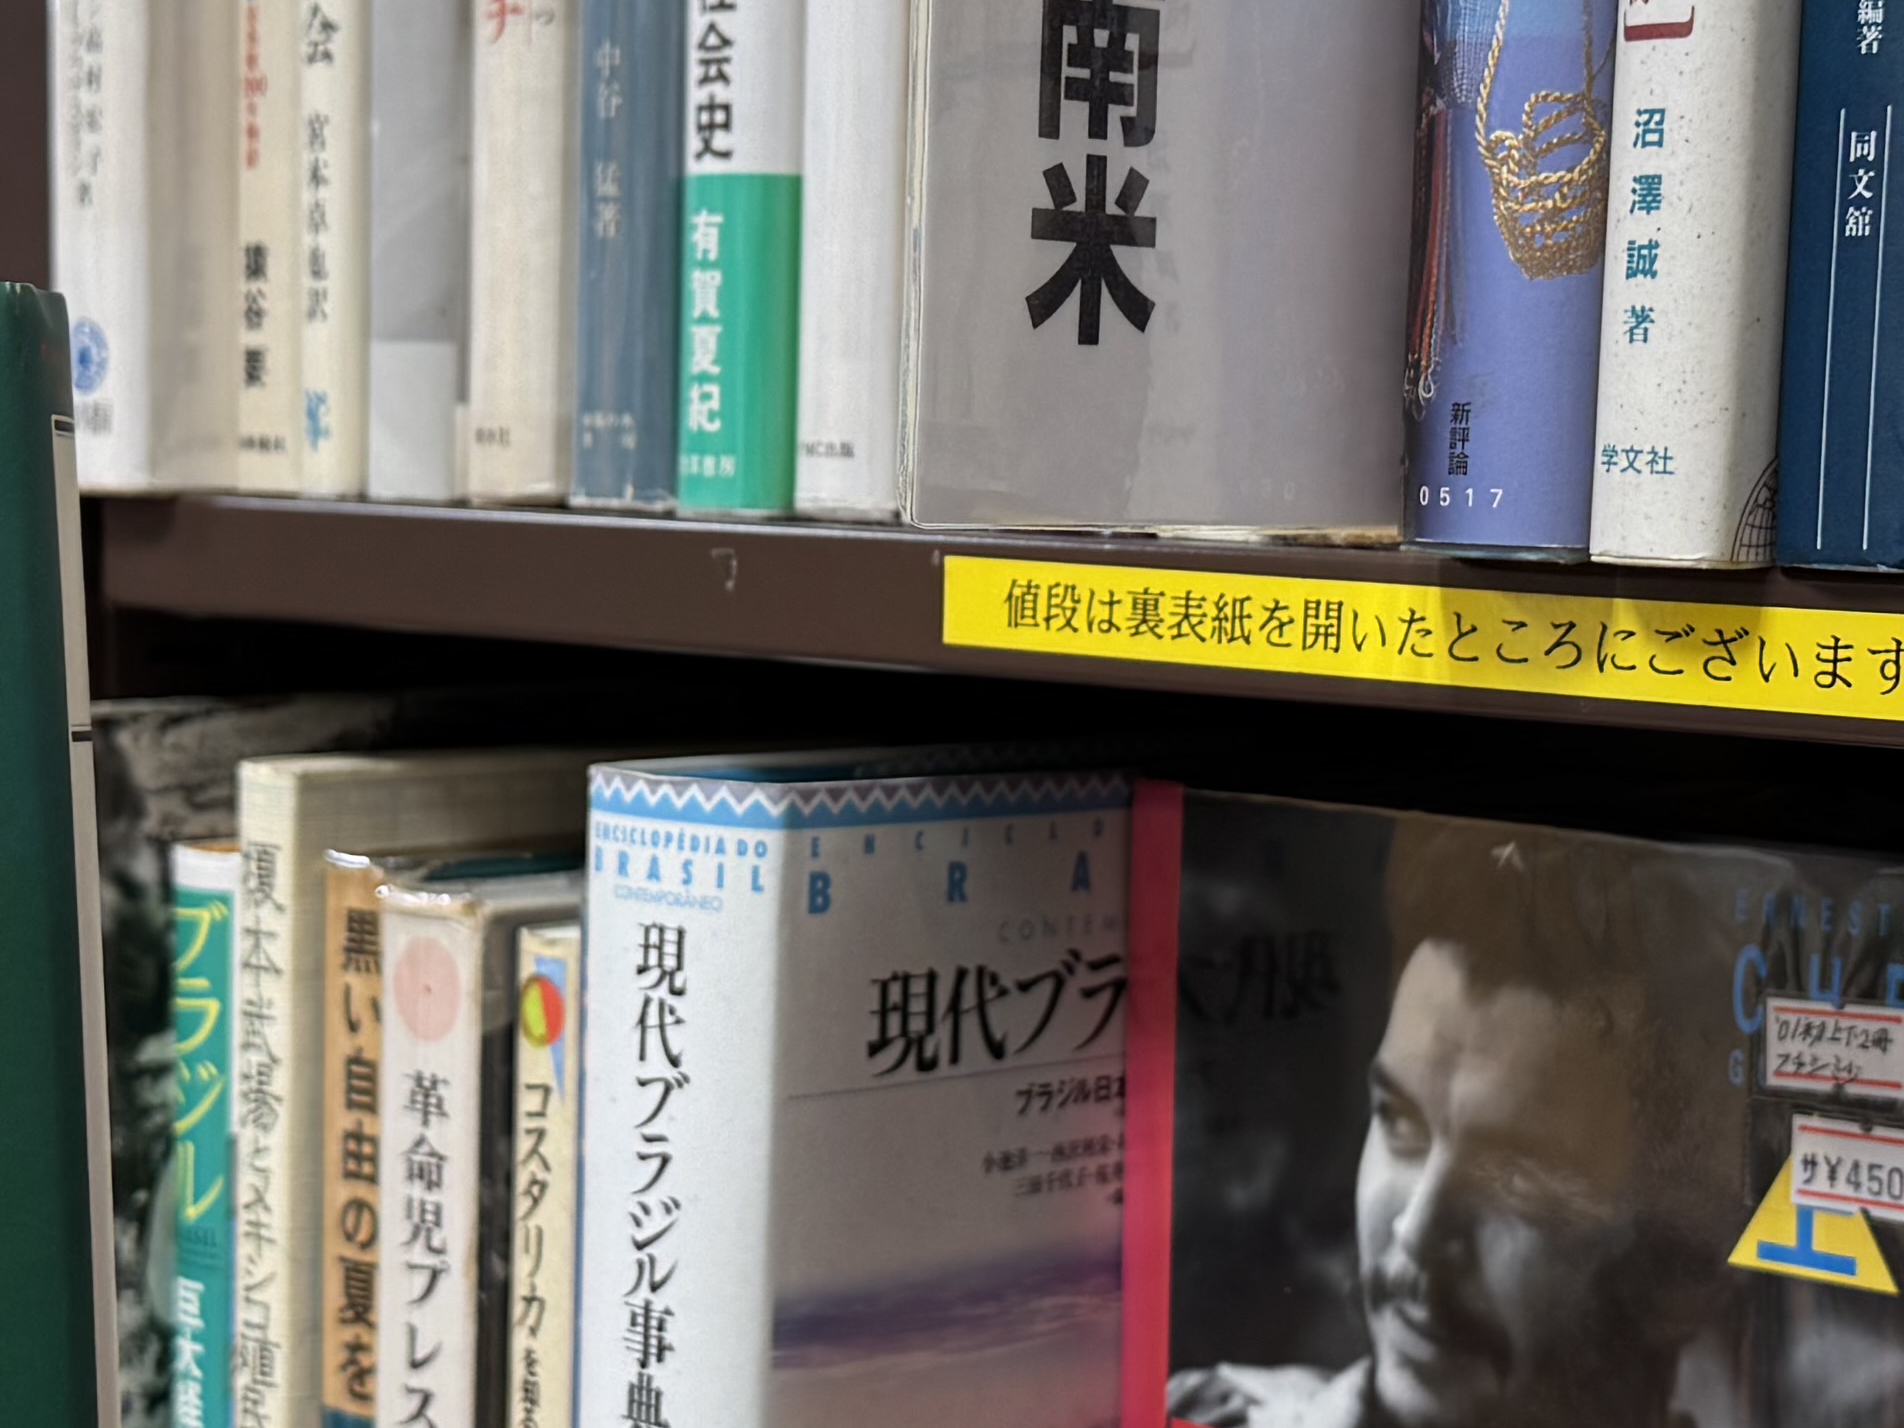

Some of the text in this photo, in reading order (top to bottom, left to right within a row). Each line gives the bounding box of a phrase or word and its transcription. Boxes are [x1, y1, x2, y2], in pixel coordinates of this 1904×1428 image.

[687, 208, 725, 435] 有賀夏紀
[1447, 400, 1473, 478] 新評論
[1600, 442, 1676, 478] 学文社
[1418, 483, 1505, 511] 0517
[736, 836, 769, 859] DO
[806, 850, 1093, 916] BRA
[865, 948, 1128, 1078] 現代ブラ
[174, 898, 230, 1225] ブラジル
[336, 907, 382, 1404] 黒い自由の夏を
